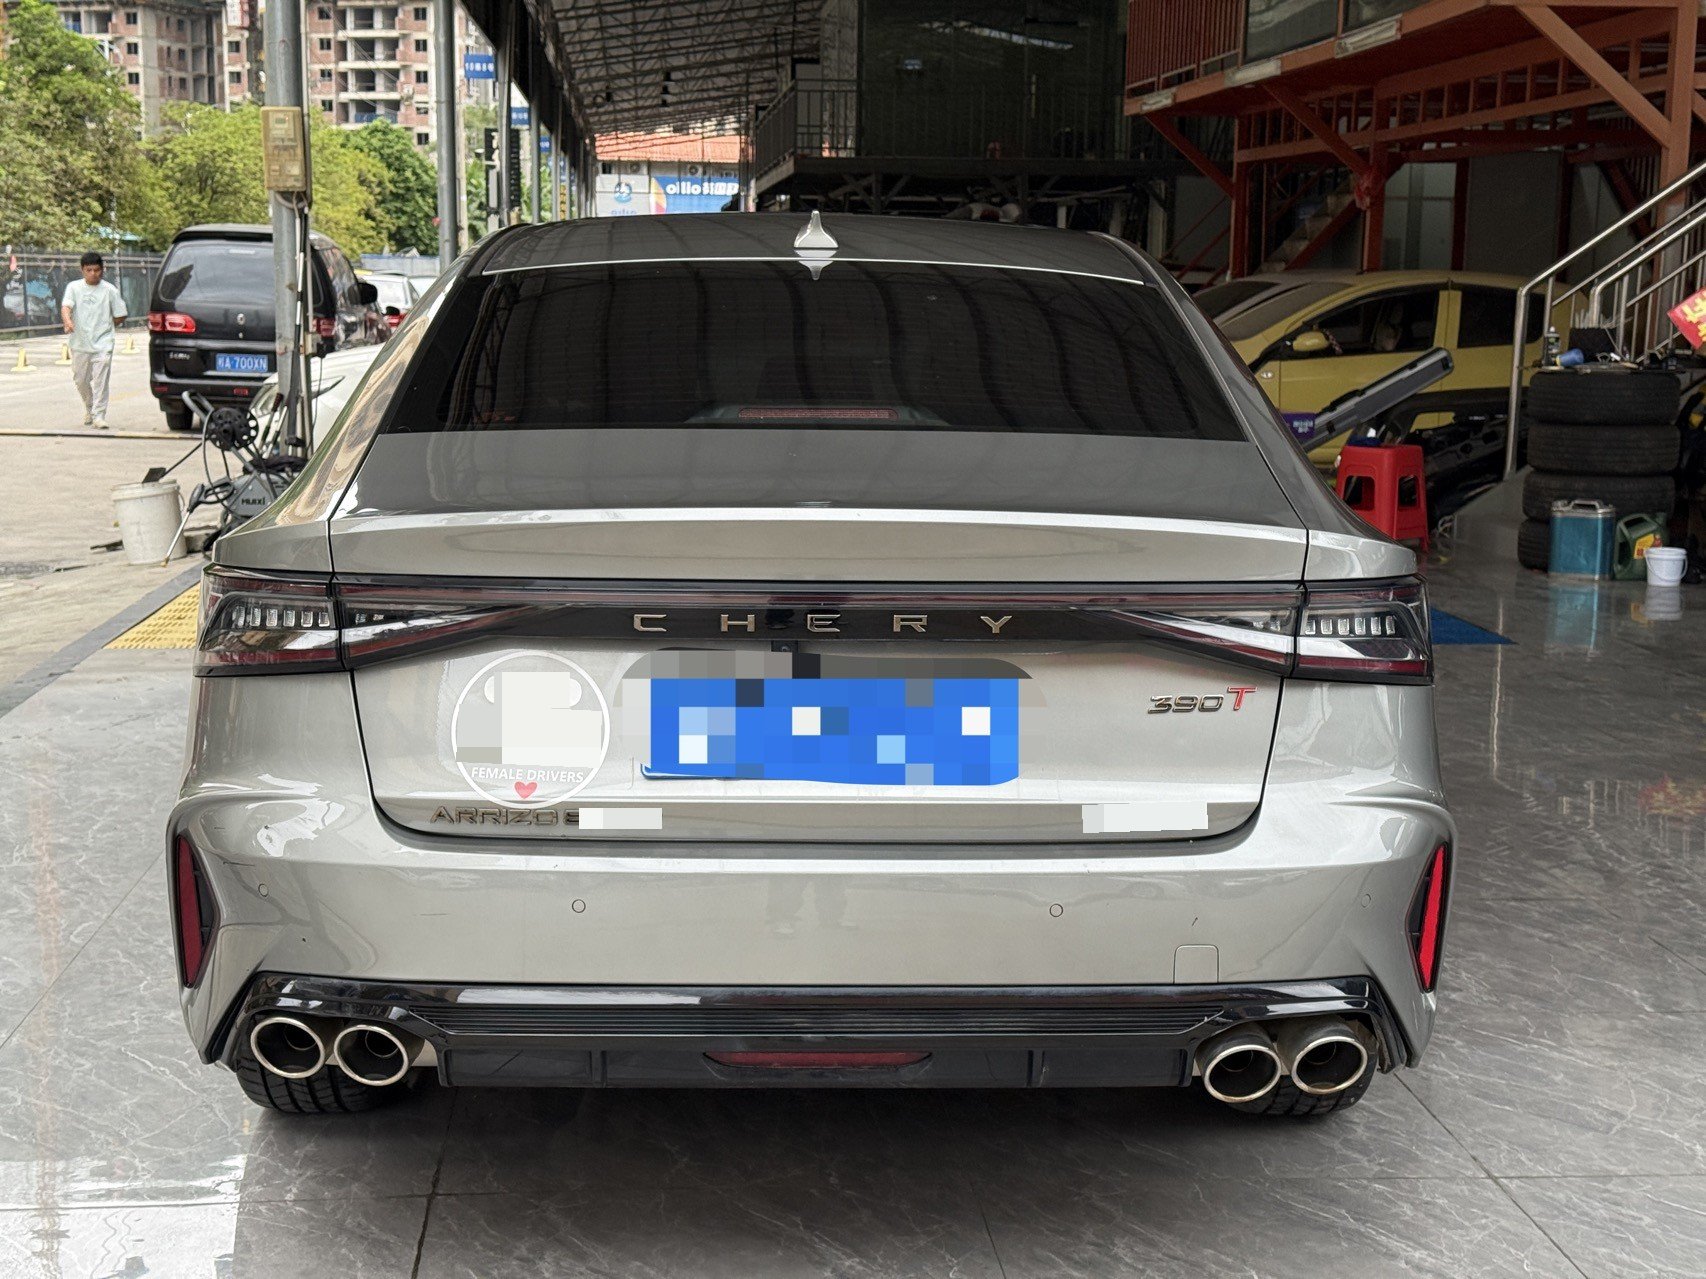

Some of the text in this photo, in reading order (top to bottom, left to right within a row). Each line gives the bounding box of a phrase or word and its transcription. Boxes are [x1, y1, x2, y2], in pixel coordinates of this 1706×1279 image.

[633, 613, 1013, 634] CHERY
[471, 766, 584, 783] FEMALE DRIVERS
[430, 806, 559, 826] ARRIZO
